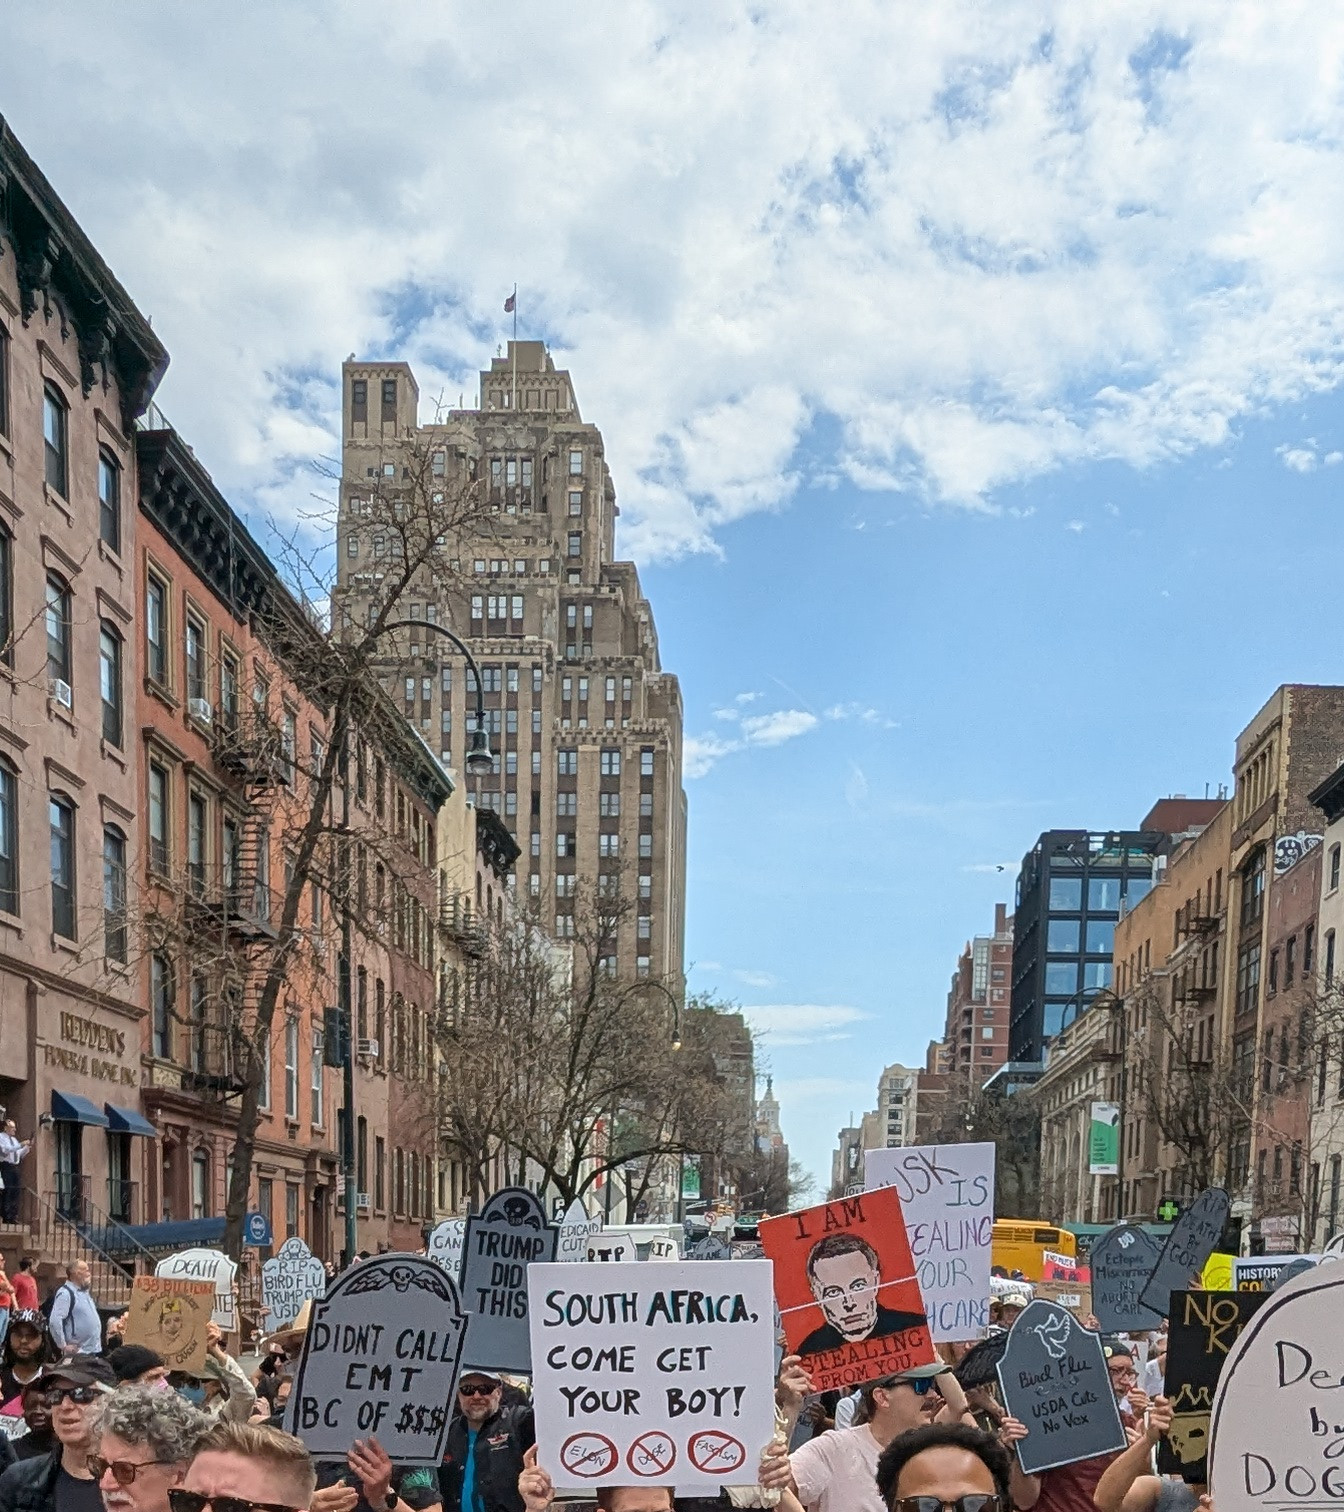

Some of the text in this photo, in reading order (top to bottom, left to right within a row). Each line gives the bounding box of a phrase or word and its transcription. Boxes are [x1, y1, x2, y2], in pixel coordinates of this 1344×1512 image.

[880, 1148, 988, 1206] USK IS
[790, 1196, 866, 1240] I AM
[476, 1229, 544, 1261] TRUMP
[172, 1259, 220, 1278] DEATH
[264, 1274, 323, 1290] BIRD FLU
[278, 1261, 309, 1274] RIP
[490, 1262, 523, 1289] DID
[264, 1289, 303, 1305] TRUMP
[476, 1288, 528, 1319] THIS
[543, 1289, 759, 1326] SOUTH AFRICA,
[1183, 1294, 1239, 1326] NO
[395, 1328, 454, 1363] CALL
[547, 1345, 712, 1372] COME GET
[801, 1329, 923, 1374] STEALING
[346, 1363, 423, 1392] EMT
[819, 1353, 919, 1391] FROM YOU.
[1018, 1364, 1054, 1389] Bird
[1057, 1356, 1092, 1378] Flu
[302, 1397, 446, 1437] BC OF $$$
[559, 1386, 746, 1418] YOUR BOY!
[1032, 1390, 1099, 1419] USDA Cuts
[1042, 1418, 1061, 1435] No
[570, 1439, 738, 1467] ELON DOGE FASCISM
